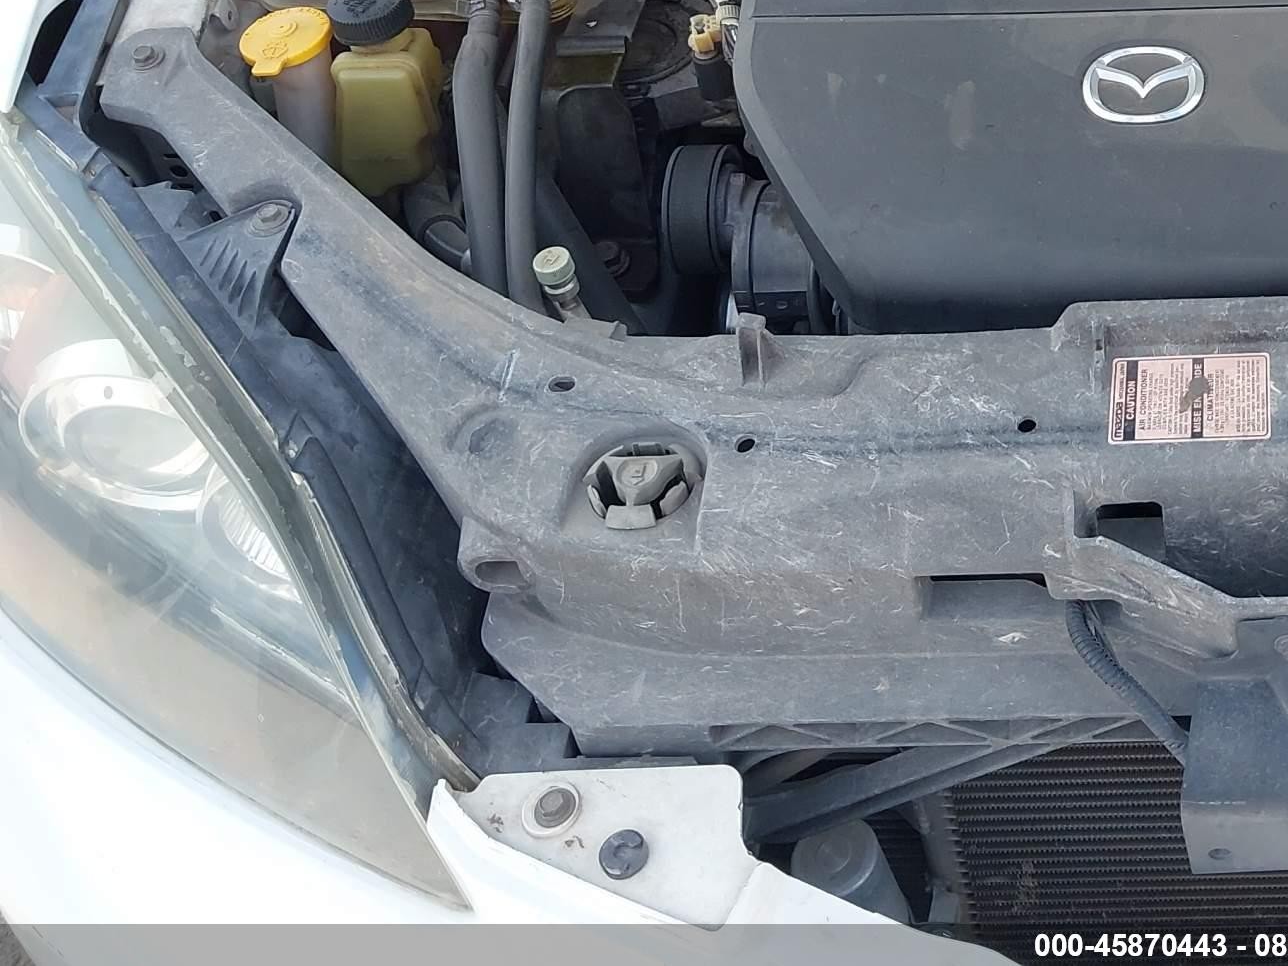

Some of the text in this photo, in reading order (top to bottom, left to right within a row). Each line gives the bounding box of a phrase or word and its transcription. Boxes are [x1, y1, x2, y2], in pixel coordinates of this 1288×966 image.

[1125, 380, 1136, 420] CAUTION
[1139, 369, 1149, 415] CONDITIONER
[1193, 410, 1202, 433] MISE
